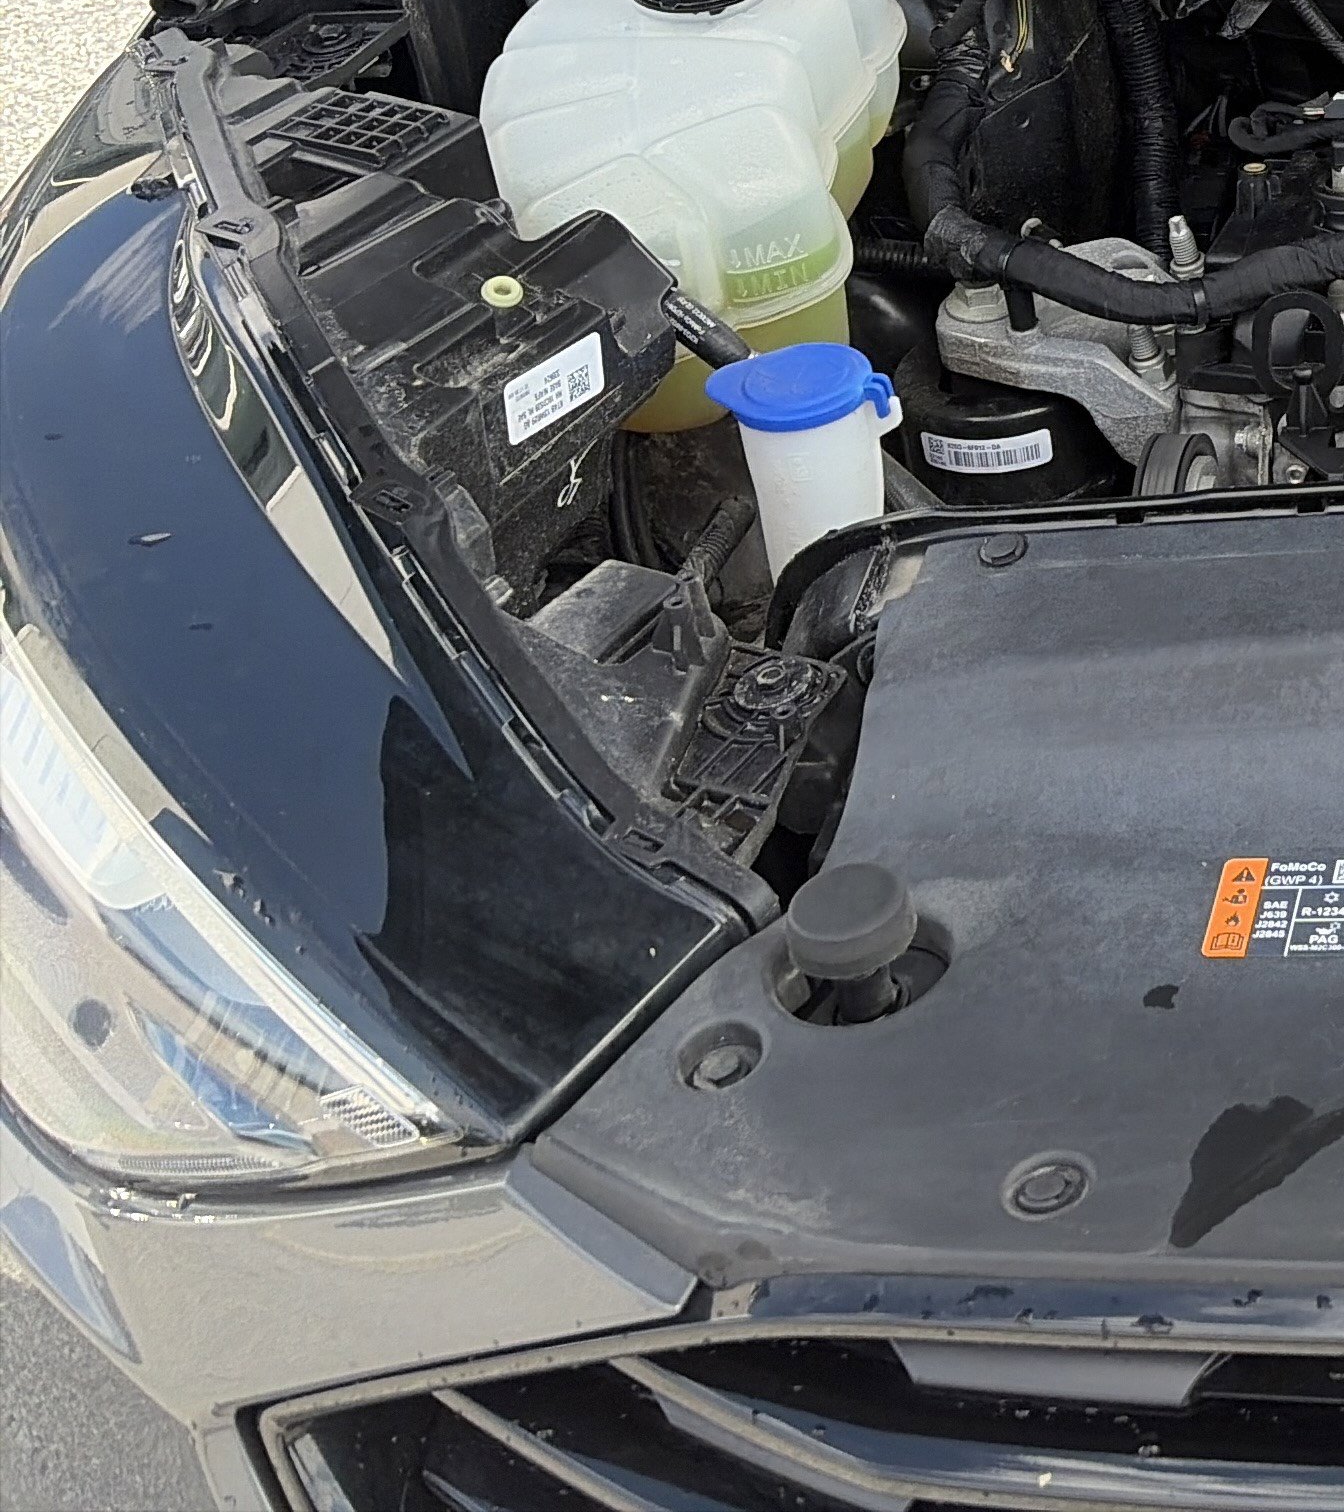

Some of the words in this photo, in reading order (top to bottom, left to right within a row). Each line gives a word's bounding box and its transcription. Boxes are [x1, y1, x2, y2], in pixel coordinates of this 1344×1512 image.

[748, 233, 804, 265] MAX
[752, 263, 809, 295] MIN
[1270, 861, 1327, 872] FoMoCo
[1264, 875, 1307, 886] (GWP
[1308, 874, 1323, 886] 4)
[1263, 900, 1289, 909] SAE
[1259, 910, 1288, 919] J639
[1308, 934, 1339, 944] PAG
